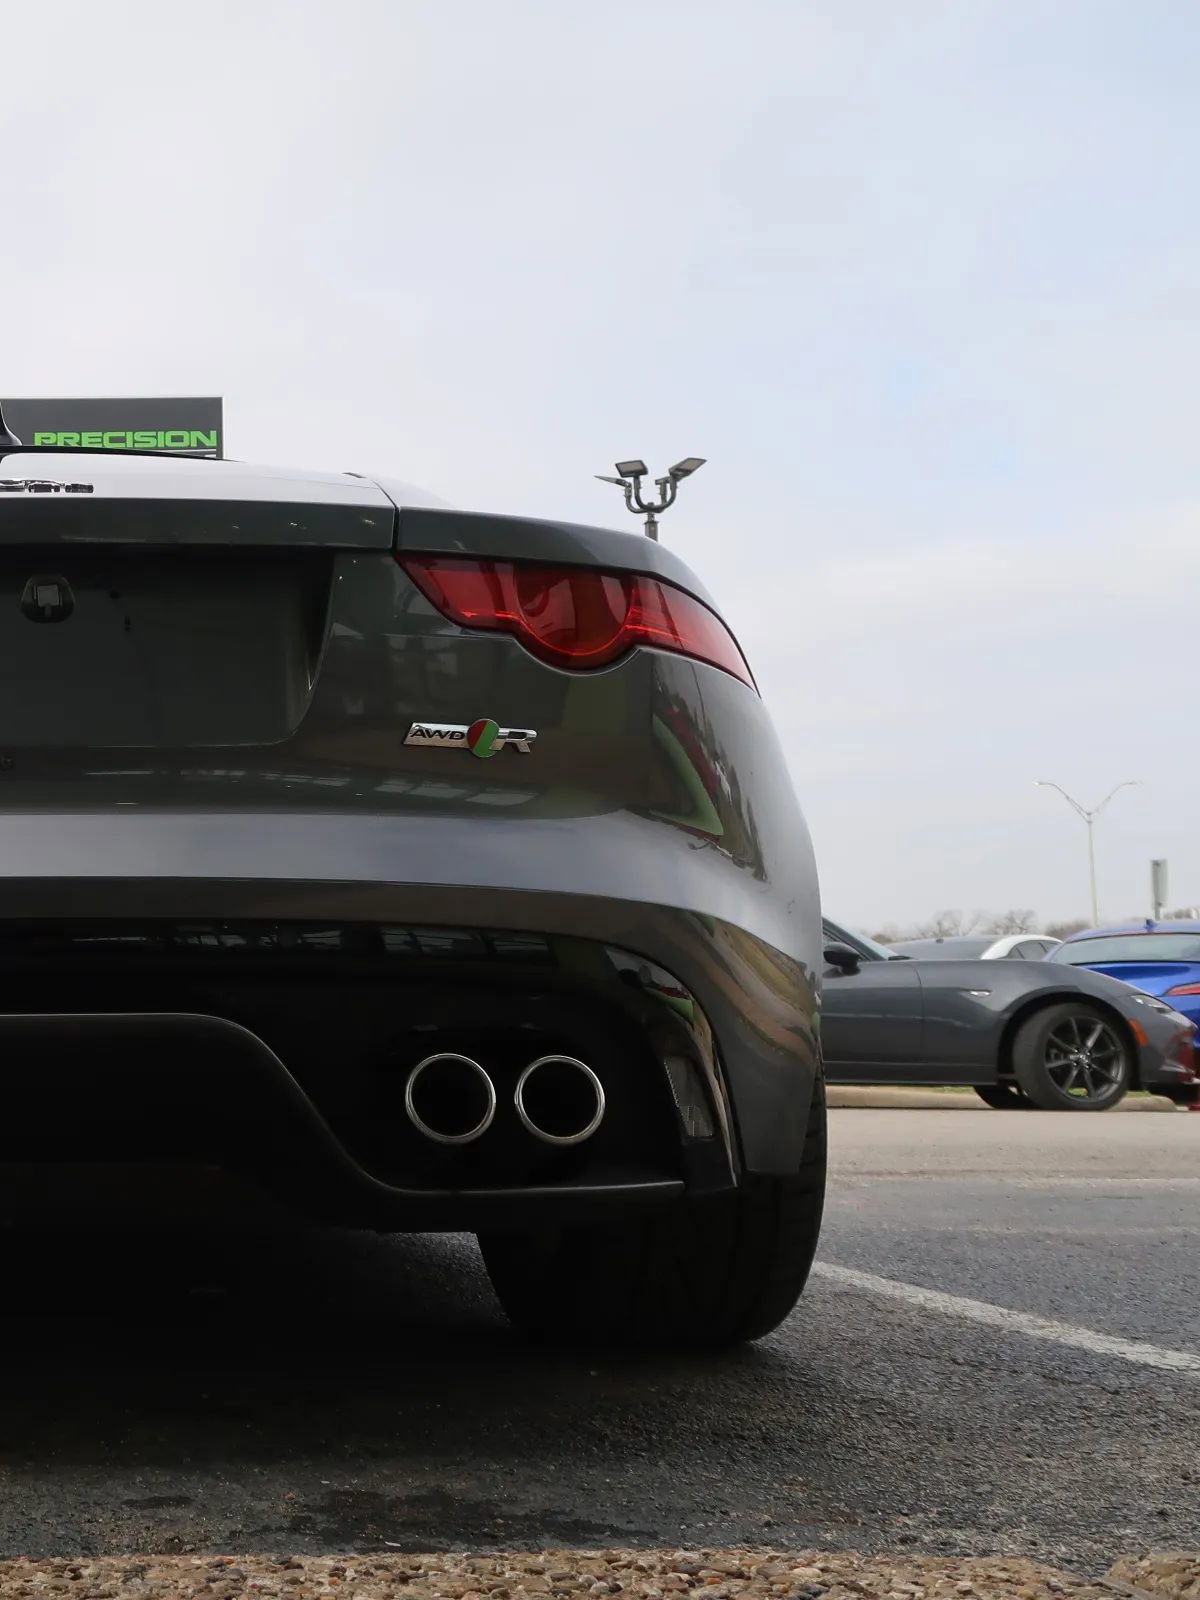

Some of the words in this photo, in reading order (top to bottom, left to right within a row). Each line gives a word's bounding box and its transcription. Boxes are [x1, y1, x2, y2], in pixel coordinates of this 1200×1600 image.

[34, 430, 217, 448] PRECISION
[409, 730, 466, 741] AWD
[489, 727, 538, 753] R
